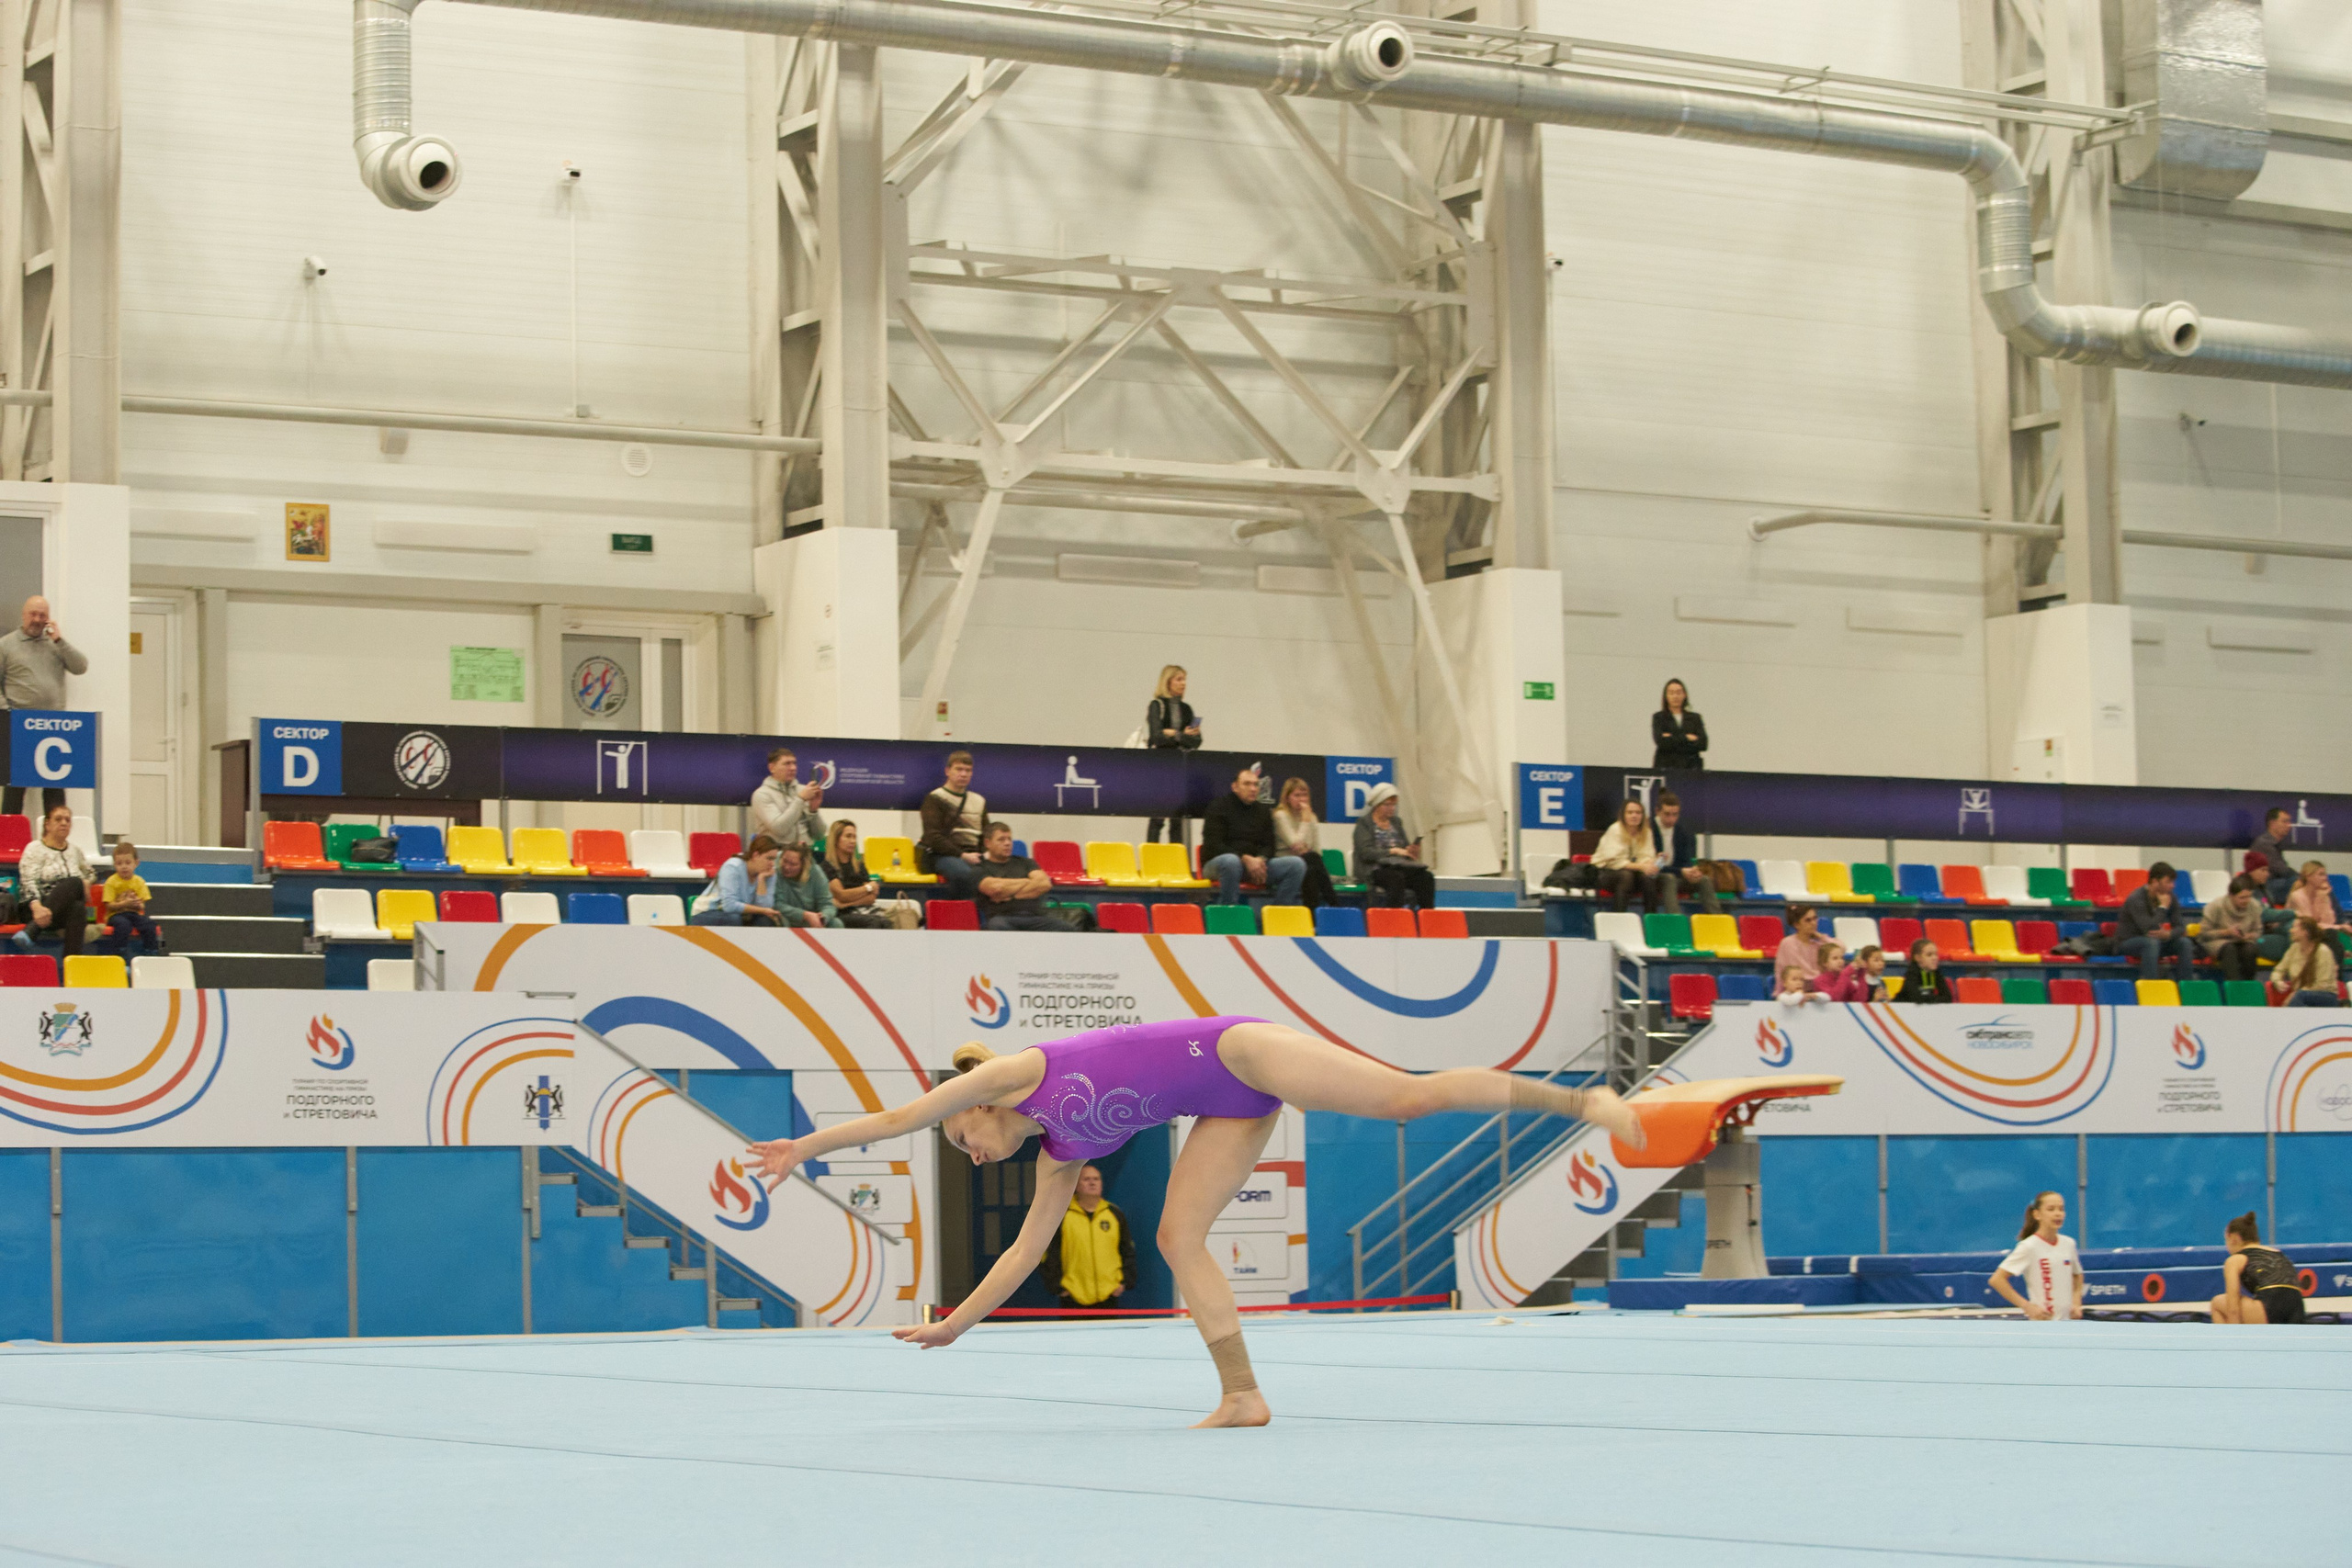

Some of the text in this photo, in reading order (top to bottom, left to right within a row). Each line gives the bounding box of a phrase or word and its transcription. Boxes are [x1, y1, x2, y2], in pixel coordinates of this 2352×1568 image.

[24, 717, 83, 731] СЕКТОР
[273, 727, 330, 740] СЕКТОР
[34, 737, 73, 781] C
[283, 745, 320, 787] D
[1336, 762, 1383, 774] СЕКТОР
[1529, 770, 1575, 783] СЕКТОР
[1344, 780, 1373, 818] D
[1539, 787, 1566, 824] E
[1019, 995, 1136, 1011] ПОДГОРНОГО
[1031, 1014, 1143, 1028] СТРЕТОВИЧА
[286, 1094, 375, 1107] ПОДГОРНОГО
[293, 1108, 379, 1120] СТРЕТОВИЧА
